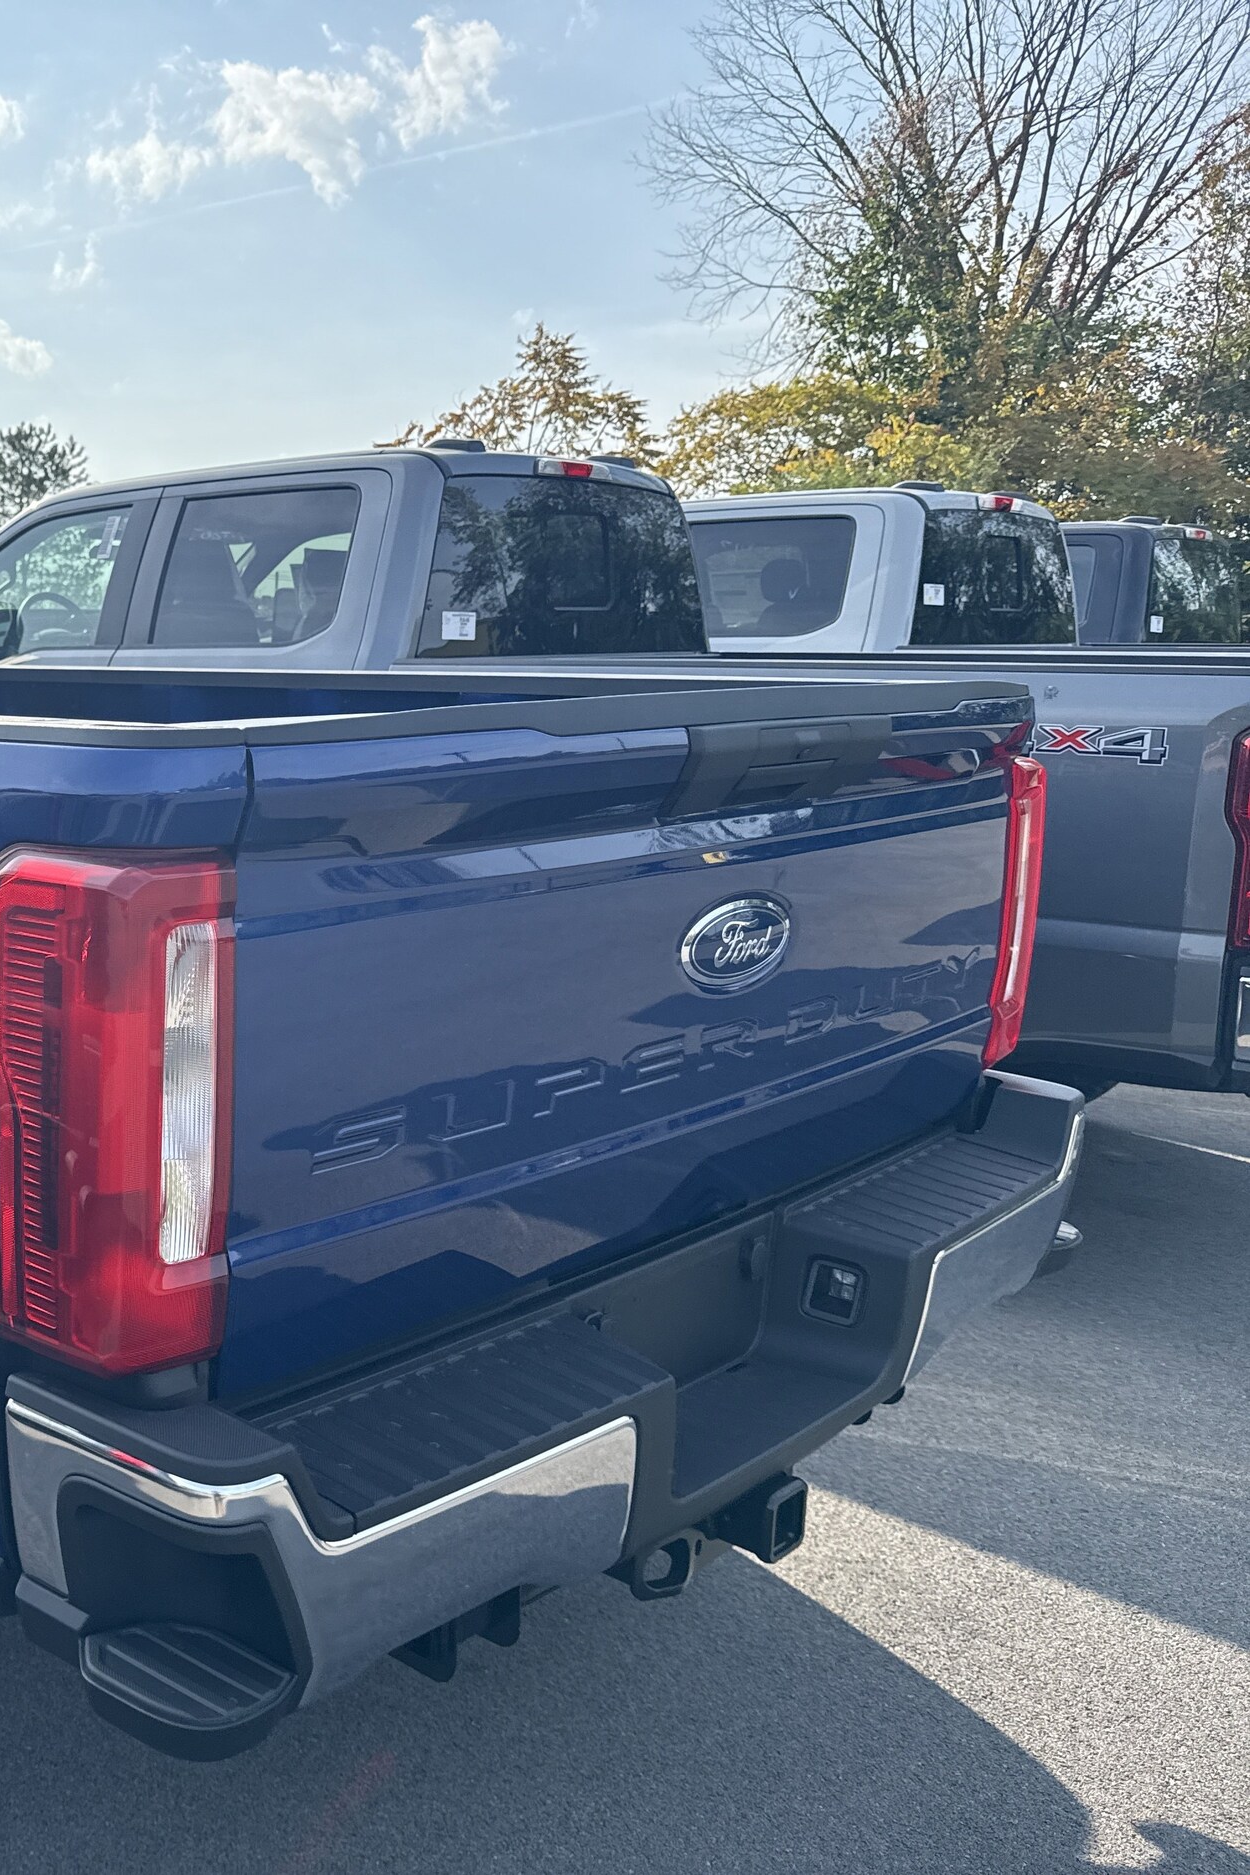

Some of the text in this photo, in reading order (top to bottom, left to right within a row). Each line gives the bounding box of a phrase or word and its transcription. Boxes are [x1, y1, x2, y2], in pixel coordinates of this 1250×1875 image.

[1026, 723, 1169, 766] X4
[714, 918, 772, 968] Ford
[310, 946, 982, 1176] SUPER DUTY
